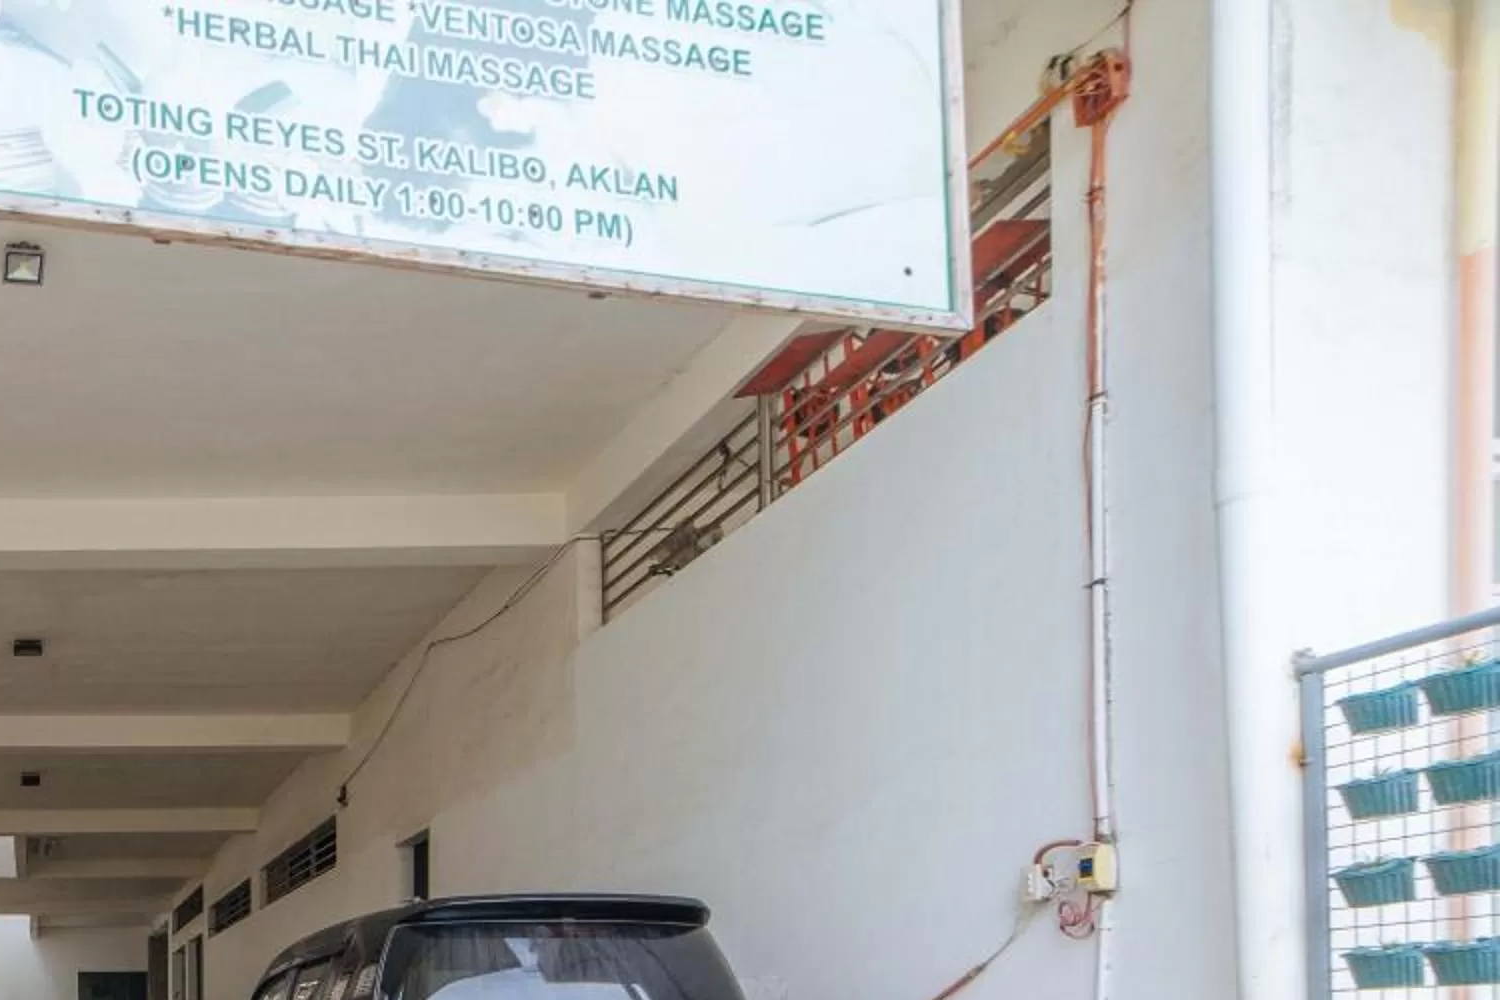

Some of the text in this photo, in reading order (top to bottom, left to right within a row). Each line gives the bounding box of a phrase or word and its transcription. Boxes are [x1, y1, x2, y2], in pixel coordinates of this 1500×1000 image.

[591, 28, 753, 75] MASSAGE
[667, 0, 825, 40] MASSAGE
[336, 34, 415, 72] THAI
[427, 49, 596, 98] MASSAGE
[73, 88, 213, 137] TOTING
[225, 112, 345, 156] REYES
[418, 140, 557, 190] KALIBO,
[566, 162, 679, 202] AKLAN
[131, 147, 634, 248] (OPENS DAILY 1:00-10:00 PM)
